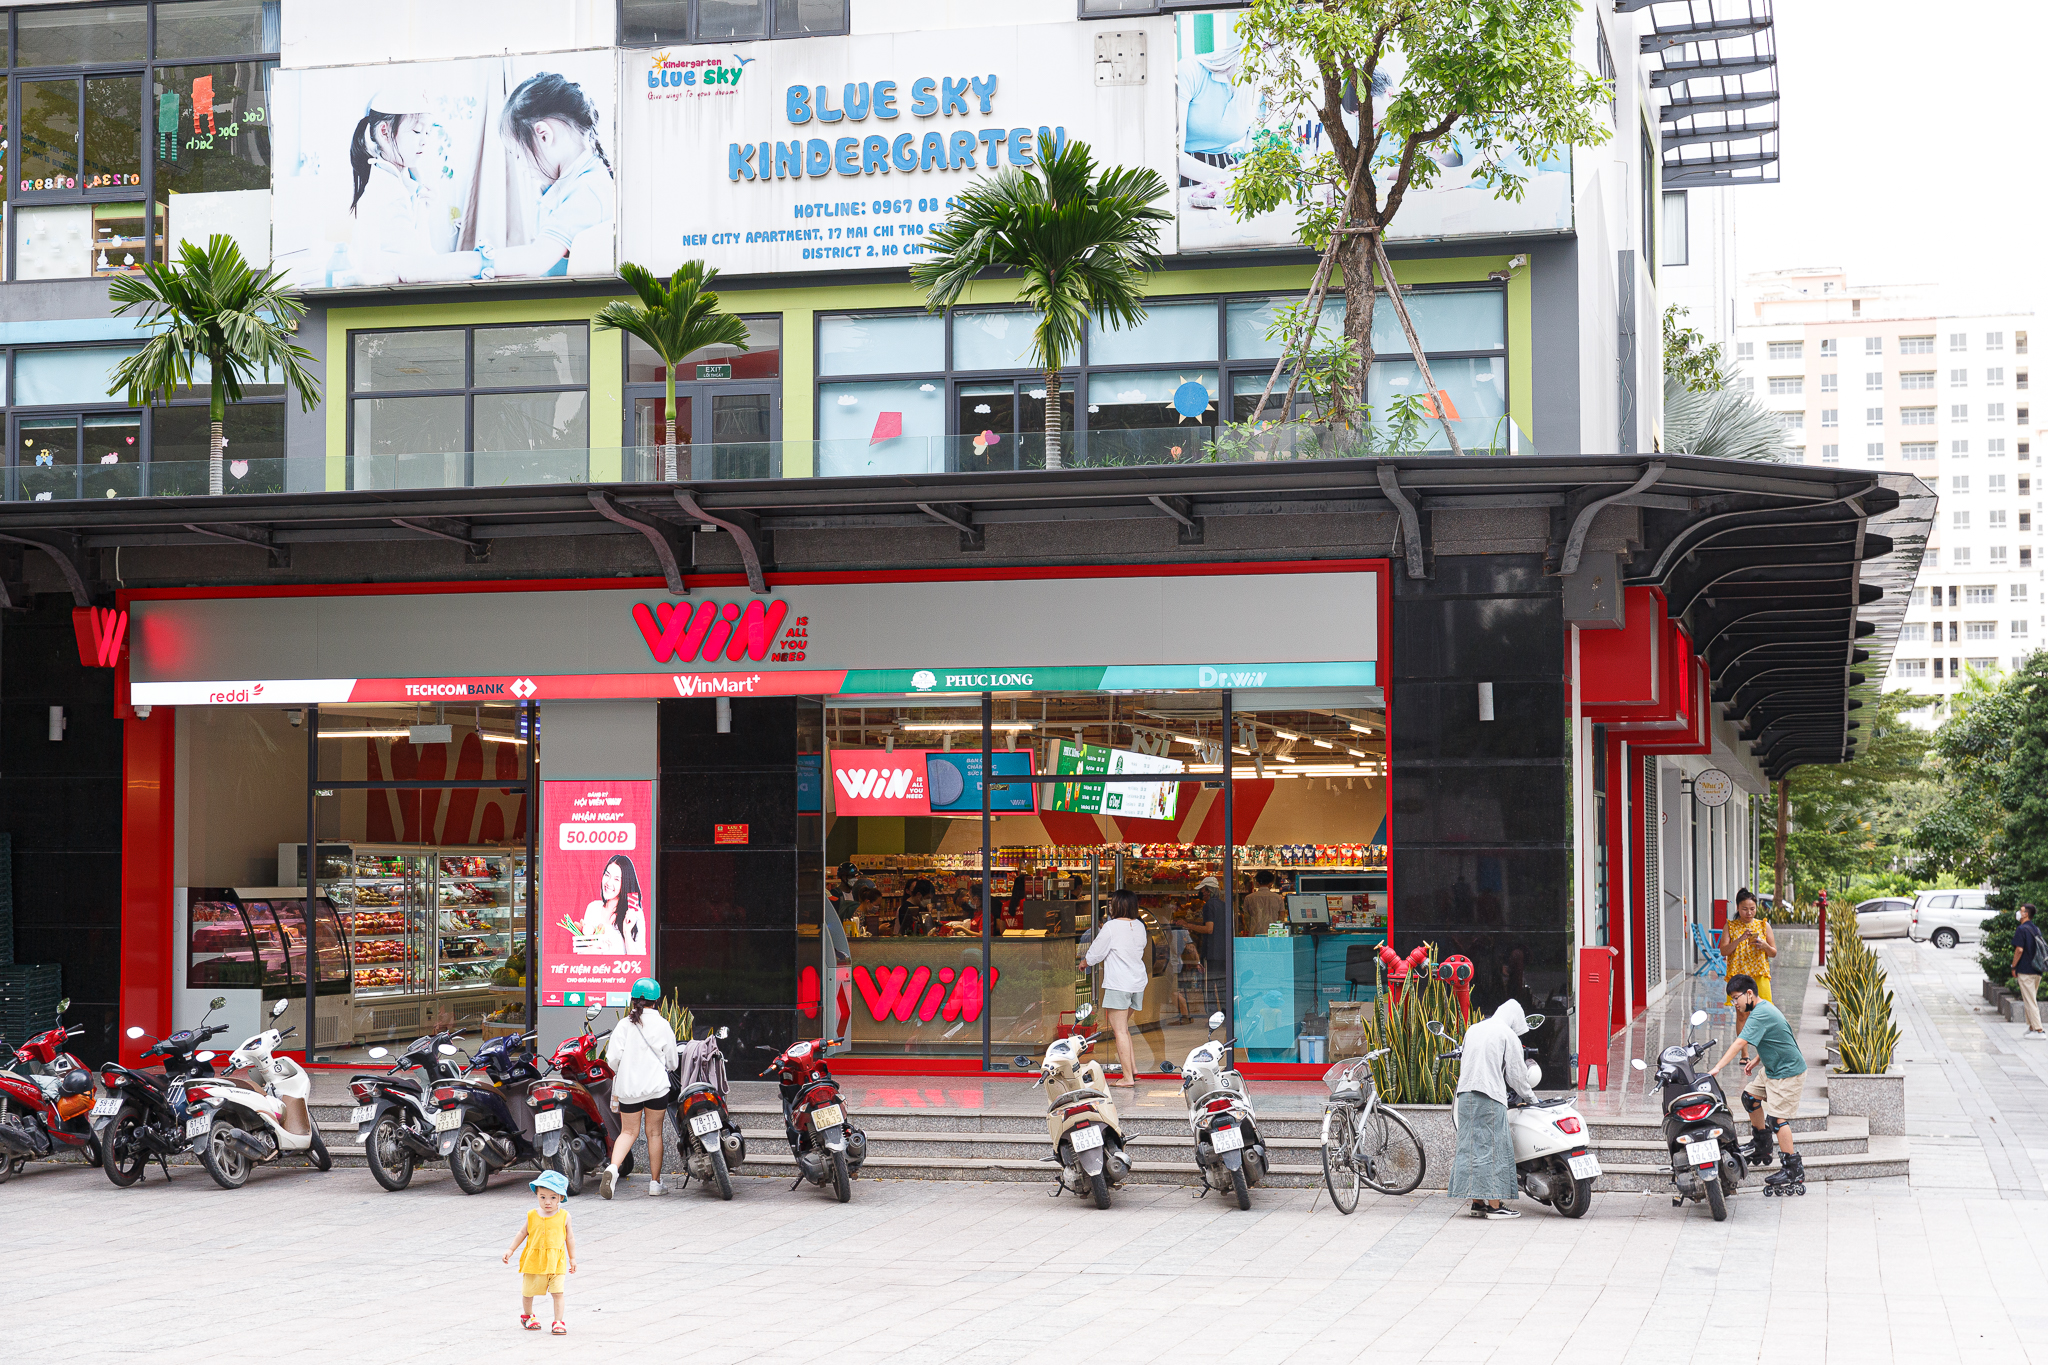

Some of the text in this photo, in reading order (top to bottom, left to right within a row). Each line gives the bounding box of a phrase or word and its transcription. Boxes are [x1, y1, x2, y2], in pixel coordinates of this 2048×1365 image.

[663, 59, 722, 69] Kindergarten
[647, 66, 743, 88] blue sky
[786, 73, 999, 125] BLUE SKY
[794, 200, 866, 219] HOTLINE:
[872, 199, 912, 215] 0967
[918, 198, 939, 213] 08
[682, 234, 707, 246] NEW
[711, 232, 741, 245] CITY
[745, 228, 823, 243] APARTMENT,
[828, 227, 842, 240] 17
[846, 226, 868, 239] MAI
[873, 225, 894, 237] CHI
[899, 223, 924, 236] THO
[802, 245, 862, 260] DISTRICT
[866, 245, 879, 258] 2,
[882, 244, 899, 256] HO
[903, 243, 924, 255] CHI
[795, 616, 809, 627] IS
[785, 628, 808, 638] ALL
[780, 640, 808, 650] YOU
[771, 652, 806, 662] NEED
[945, 673, 1033, 687] PHUC LONG
[209, 688, 249, 703] reddi
[405, 683, 505, 697] TECHCOMBANK
[612, 960, 642, 974] 20%
